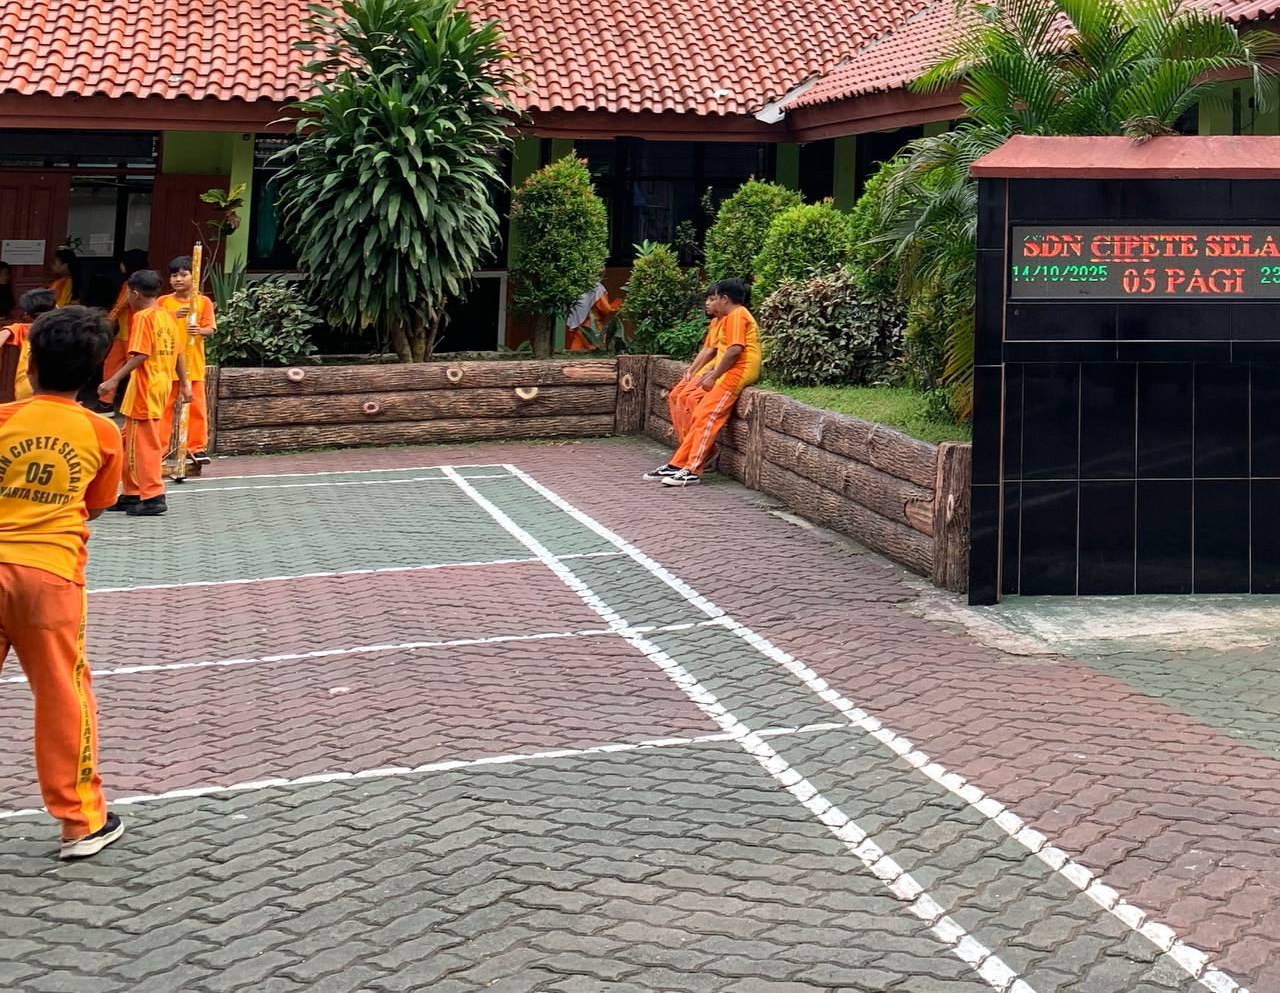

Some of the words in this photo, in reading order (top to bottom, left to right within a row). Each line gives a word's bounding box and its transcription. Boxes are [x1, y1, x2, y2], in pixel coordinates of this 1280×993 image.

[1023, 232, 1084, 257] SDN
[1090, 232, 1198, 257] CIPETE
[1012, 265, 1108, 282] 14/10/2025
[1122, 268, 1157, 294] 05
[1164, 268, 1246, 294] PAGI
[10, 436, 60, 458] CIPETE
[58, 442, 82, 493] SELATAN
[25, 461, 55, 486] 05
[31, 490, 74, 505] SELATA
